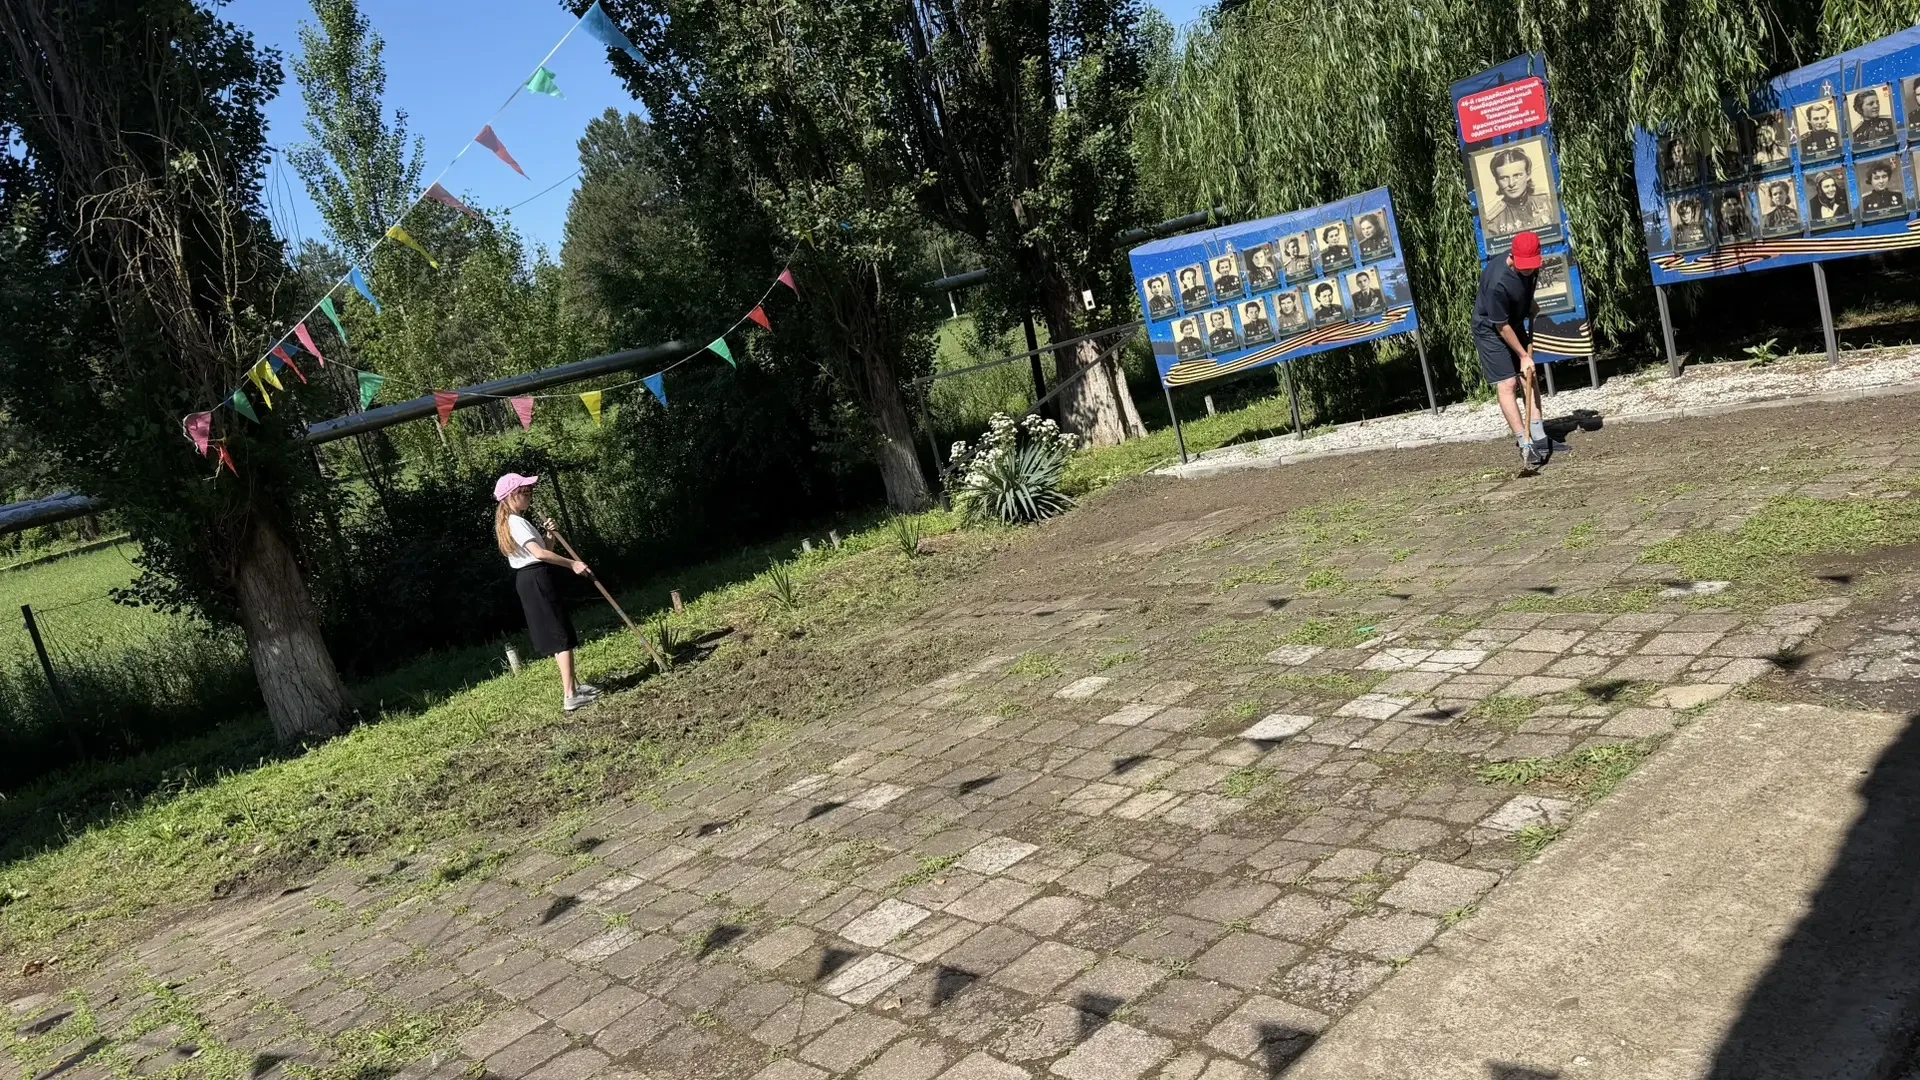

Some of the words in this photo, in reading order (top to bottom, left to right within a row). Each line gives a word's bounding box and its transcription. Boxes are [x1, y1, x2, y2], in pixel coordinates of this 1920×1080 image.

[1469, 90, 1532, 111] бомбардировочный
[1475, 88, 1514, 103] гвардейский
[1515, 80, 1539, 91] ночной
[1480, 99, 1523, 115] авиационный
[1486, 107, 1519, 120] Таманский
[1471, 127, 1493, 138] ордена
[1493, 120, 1523, 131] Суворова
